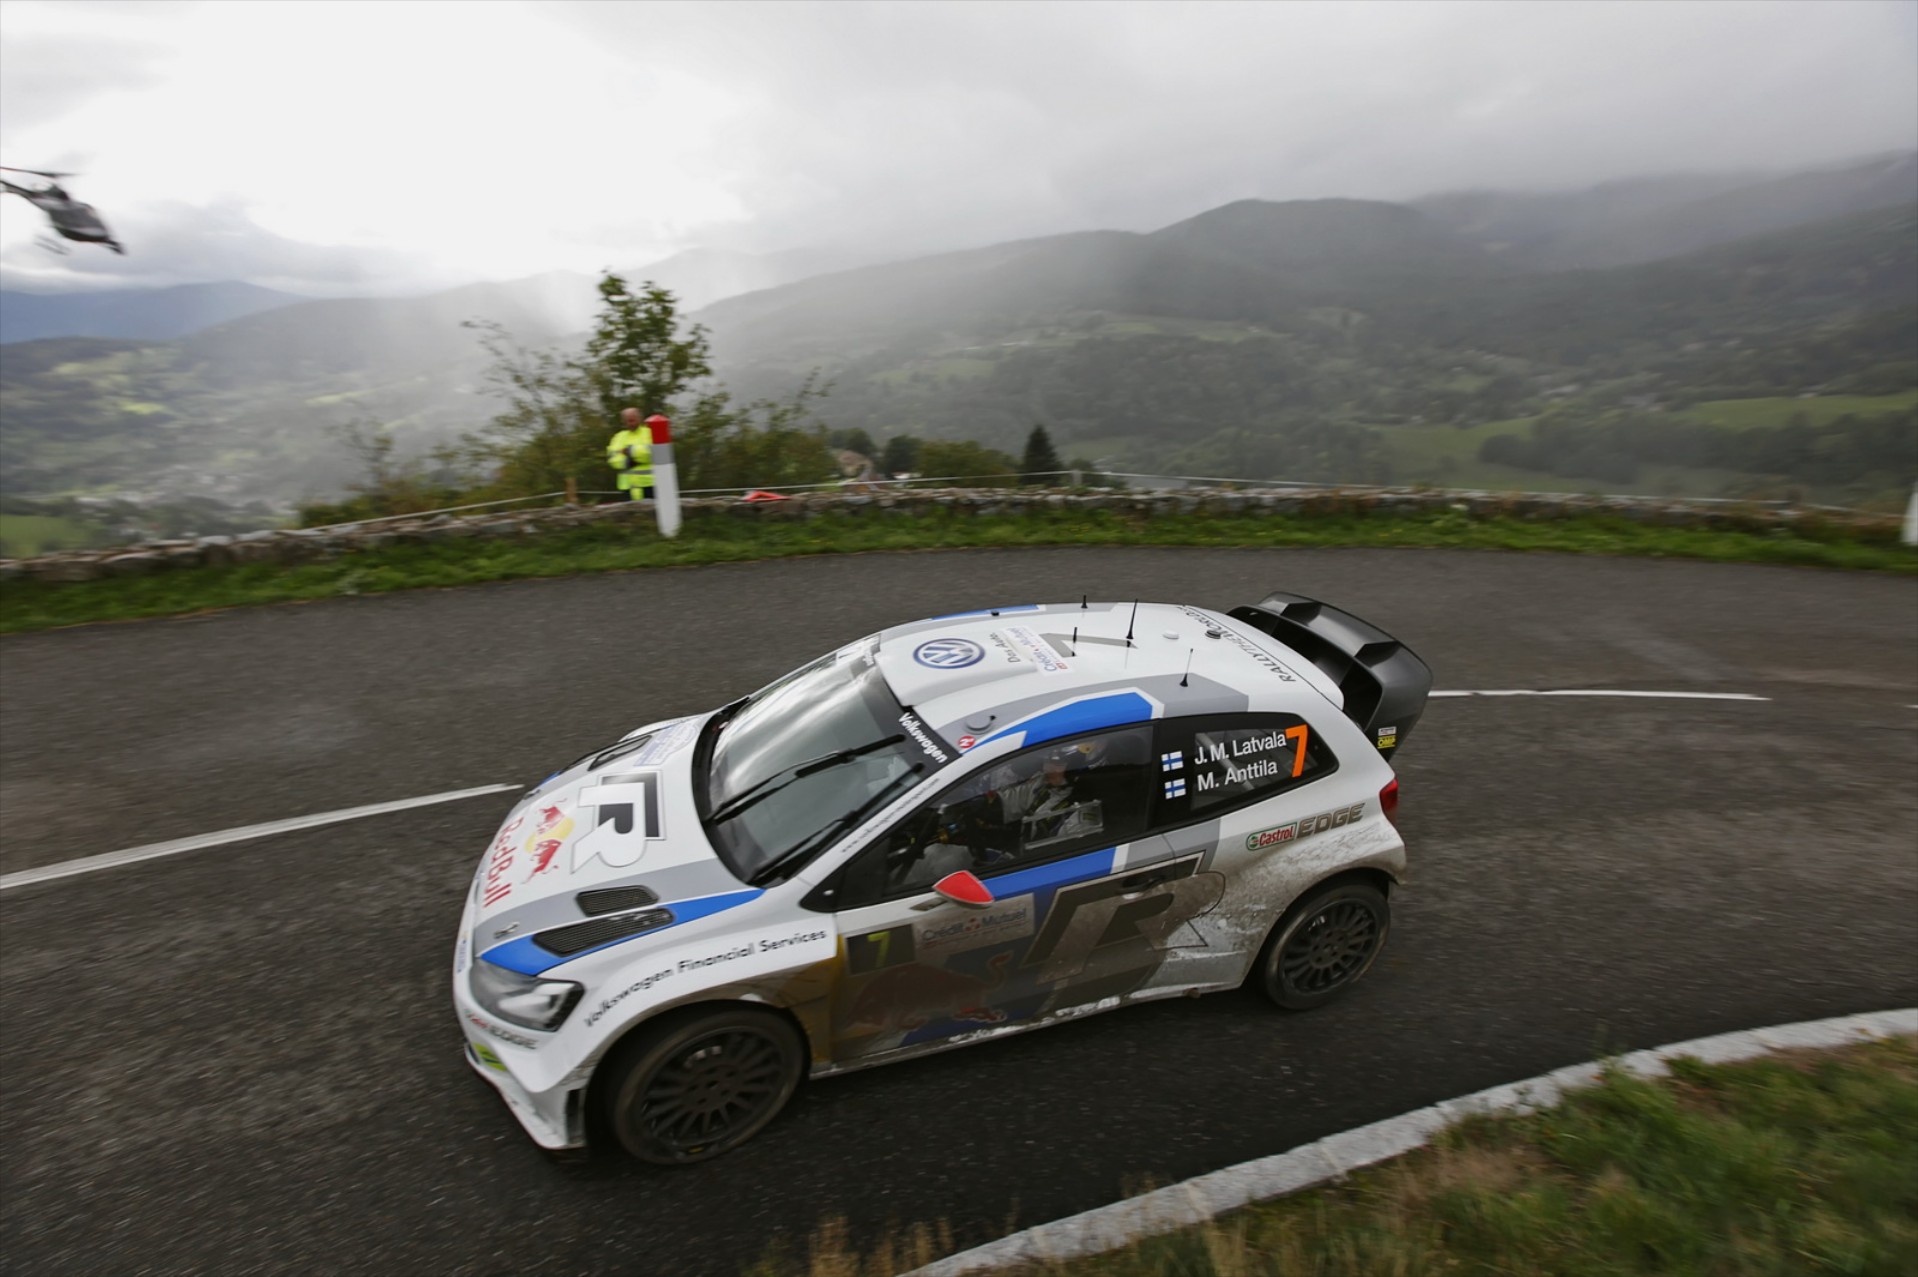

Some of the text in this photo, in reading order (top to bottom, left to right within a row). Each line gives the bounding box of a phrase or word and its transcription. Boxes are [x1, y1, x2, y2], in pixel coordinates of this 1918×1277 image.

[898, 712, 948, 764] Volkswagen
[1195, 731, 1287, 765] J. M. Latvala
[1285, 724, 1308, 778] 7
[1197, 759, 1278, 792] M. Anttila
[1260, 802, 1366, 847] Castrol EDGE
[483, 855, 513, 908] Bull
[867, 931, 891, 968] 7
[584, 928, 827, 1028] Volkswagen Financial Services
